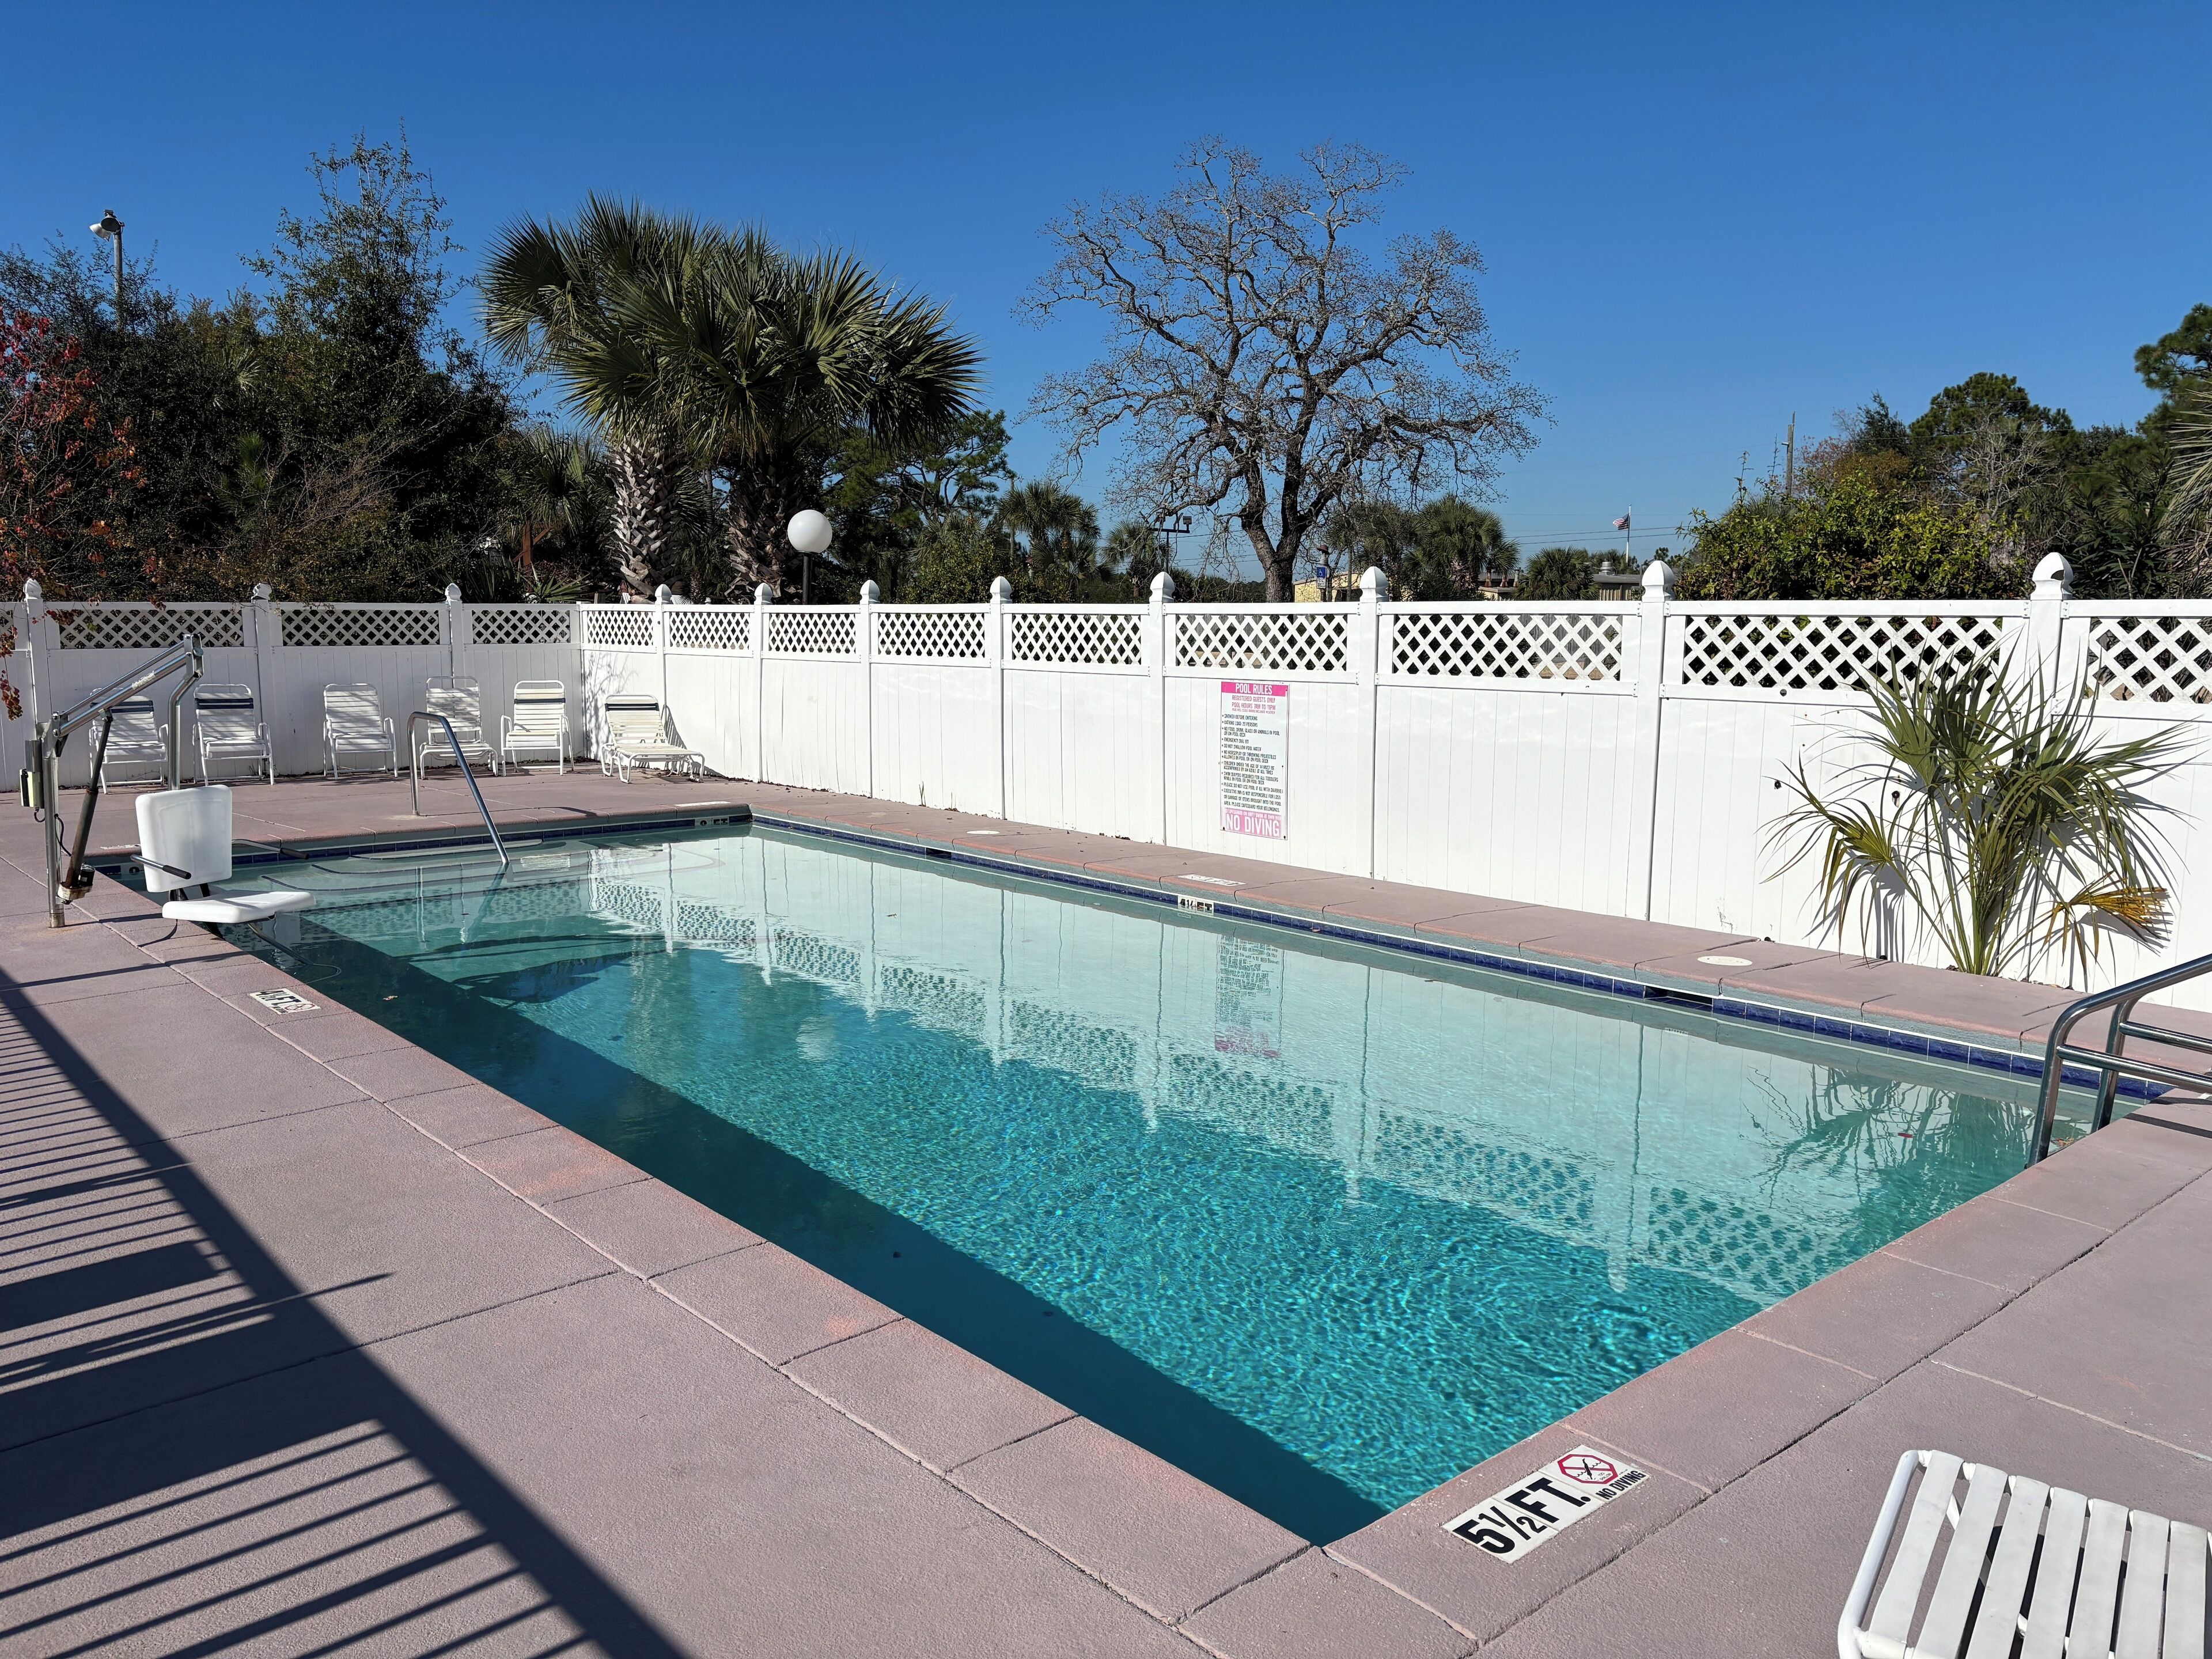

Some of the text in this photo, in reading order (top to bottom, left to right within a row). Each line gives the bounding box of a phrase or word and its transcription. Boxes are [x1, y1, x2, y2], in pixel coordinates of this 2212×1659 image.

[1235, 683, 1272, 695] POOL RULES
[1226, 813, 1279, 836] NO DIVING
[1595, 1470, 1647, 1500] NO DIVING
[1504, 1477, 1591, 1524] FT.
